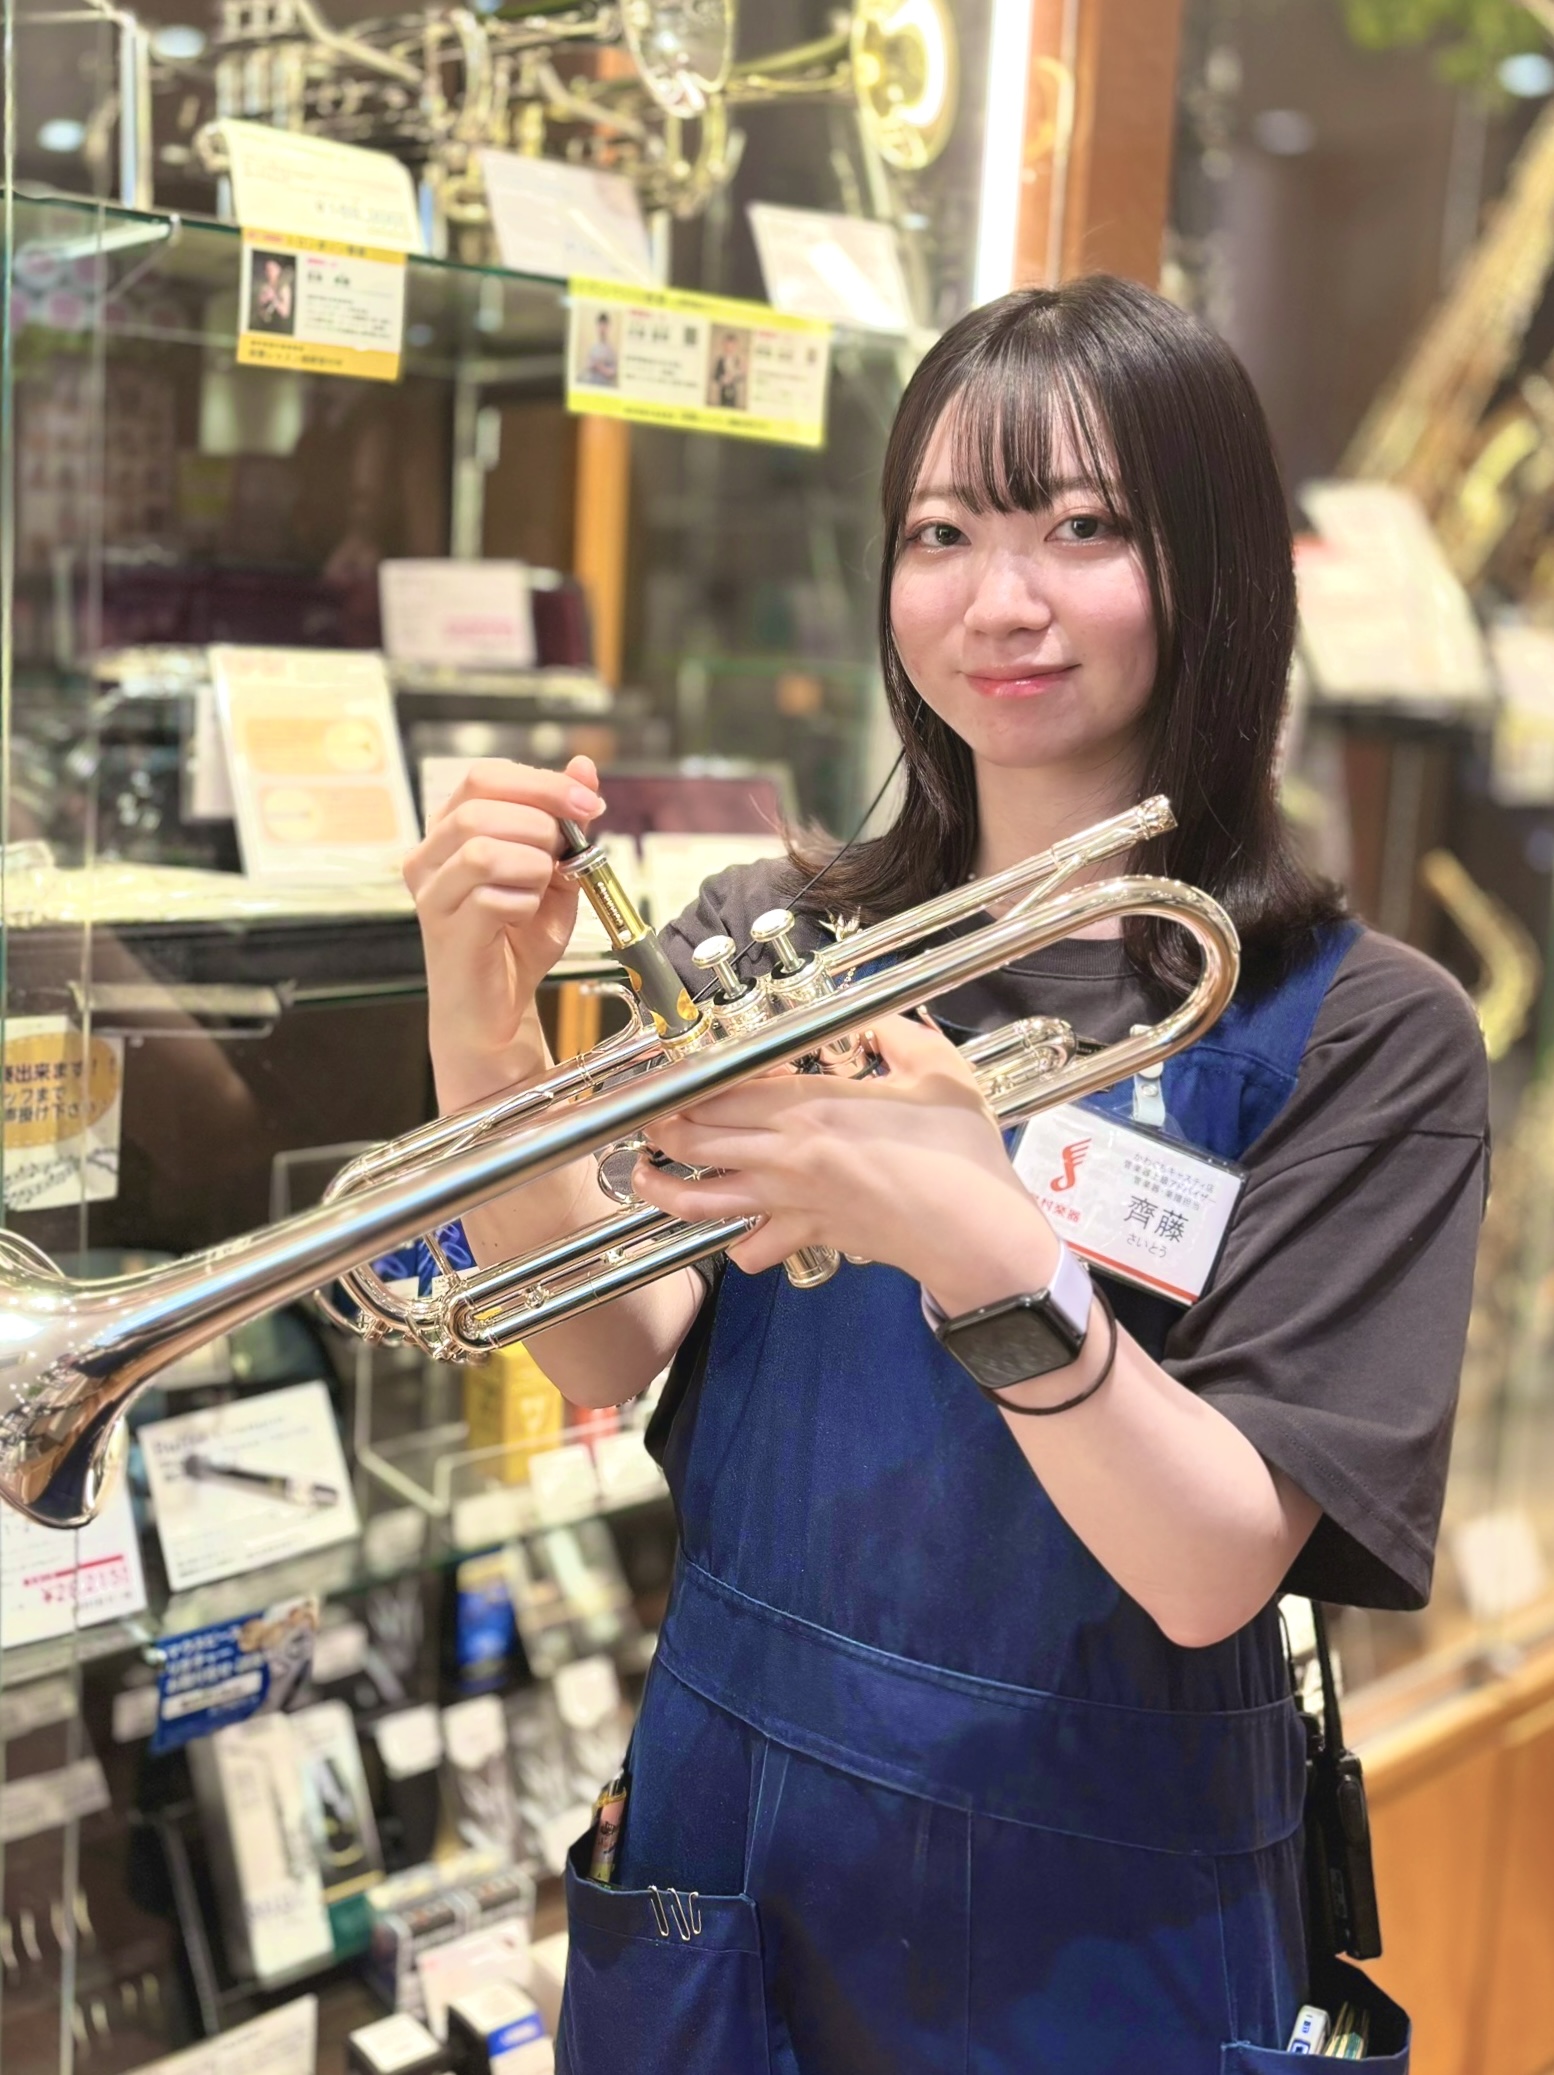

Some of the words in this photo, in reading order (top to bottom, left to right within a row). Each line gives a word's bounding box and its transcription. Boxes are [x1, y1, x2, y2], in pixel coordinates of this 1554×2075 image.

[1035, 1195, 1082, 1224] 村楽器
[1123, 1194, 1190, 1243] 齊藤
[1126, 1232, 1168, 1259] さいとう
